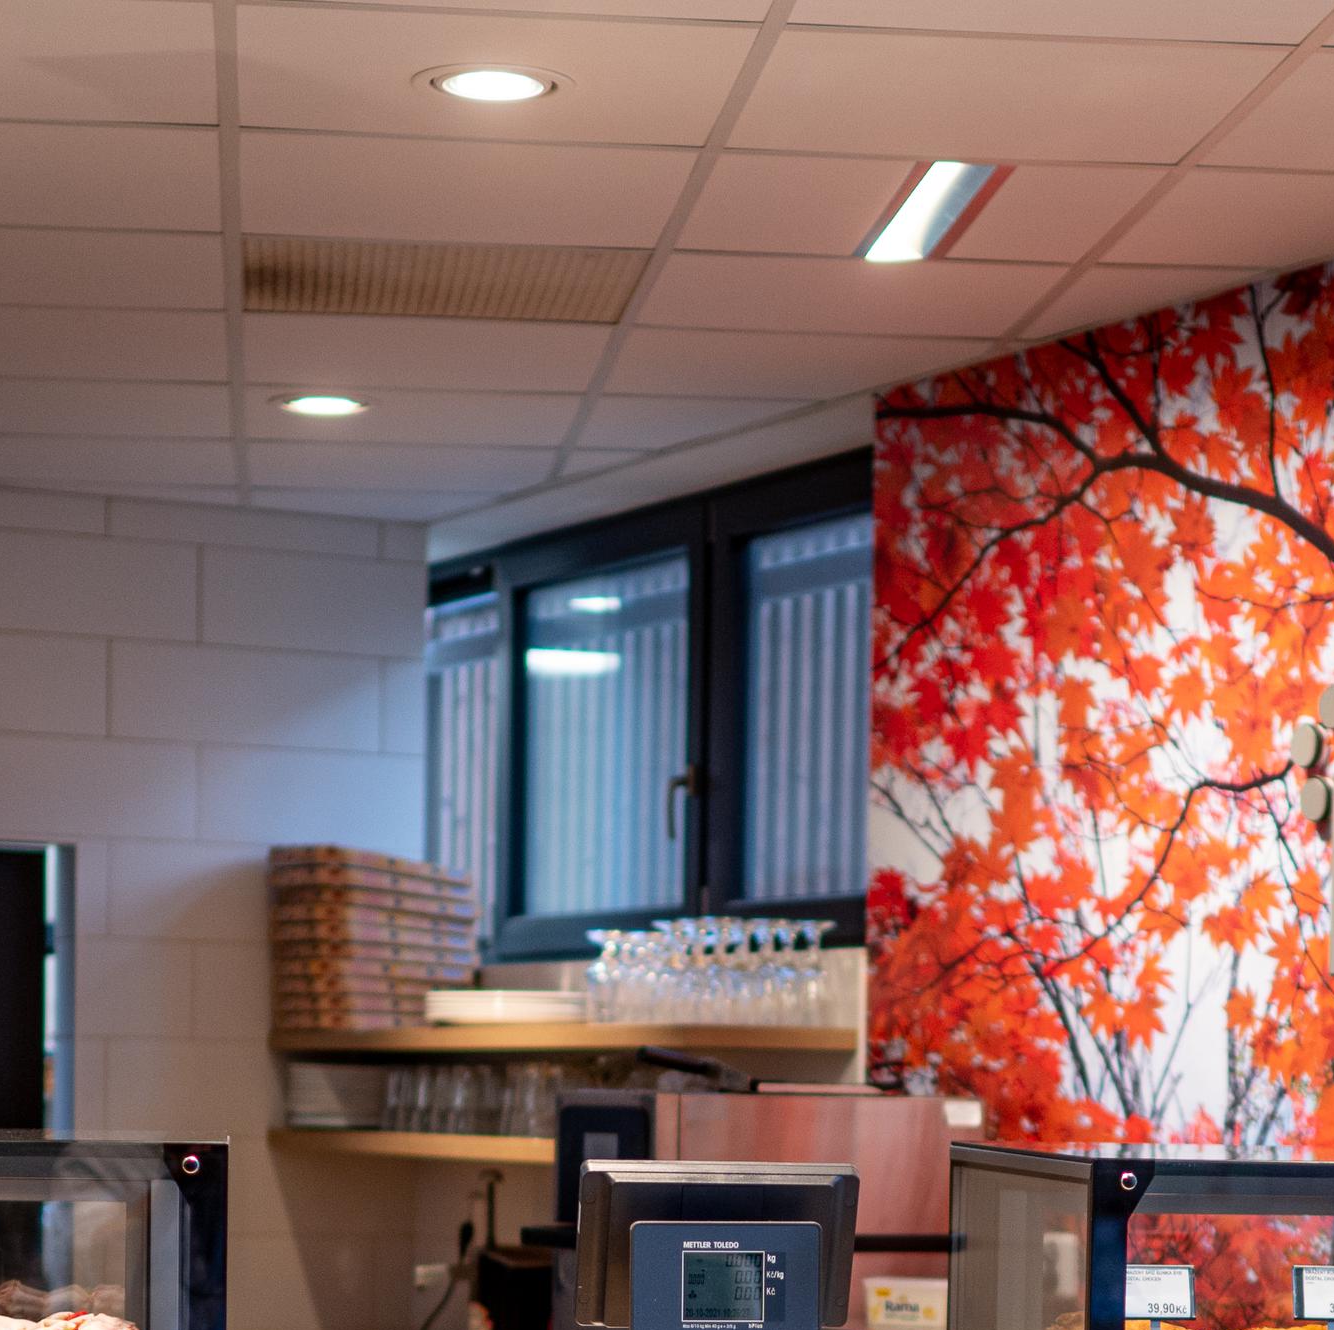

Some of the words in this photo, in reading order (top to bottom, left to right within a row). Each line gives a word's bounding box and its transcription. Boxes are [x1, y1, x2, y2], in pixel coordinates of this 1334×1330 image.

[767, 1254, 776, 1263] kg
[766, 1271, 784, 1280] Kč/kg
[766, 1287, 776, 1295] Kč
